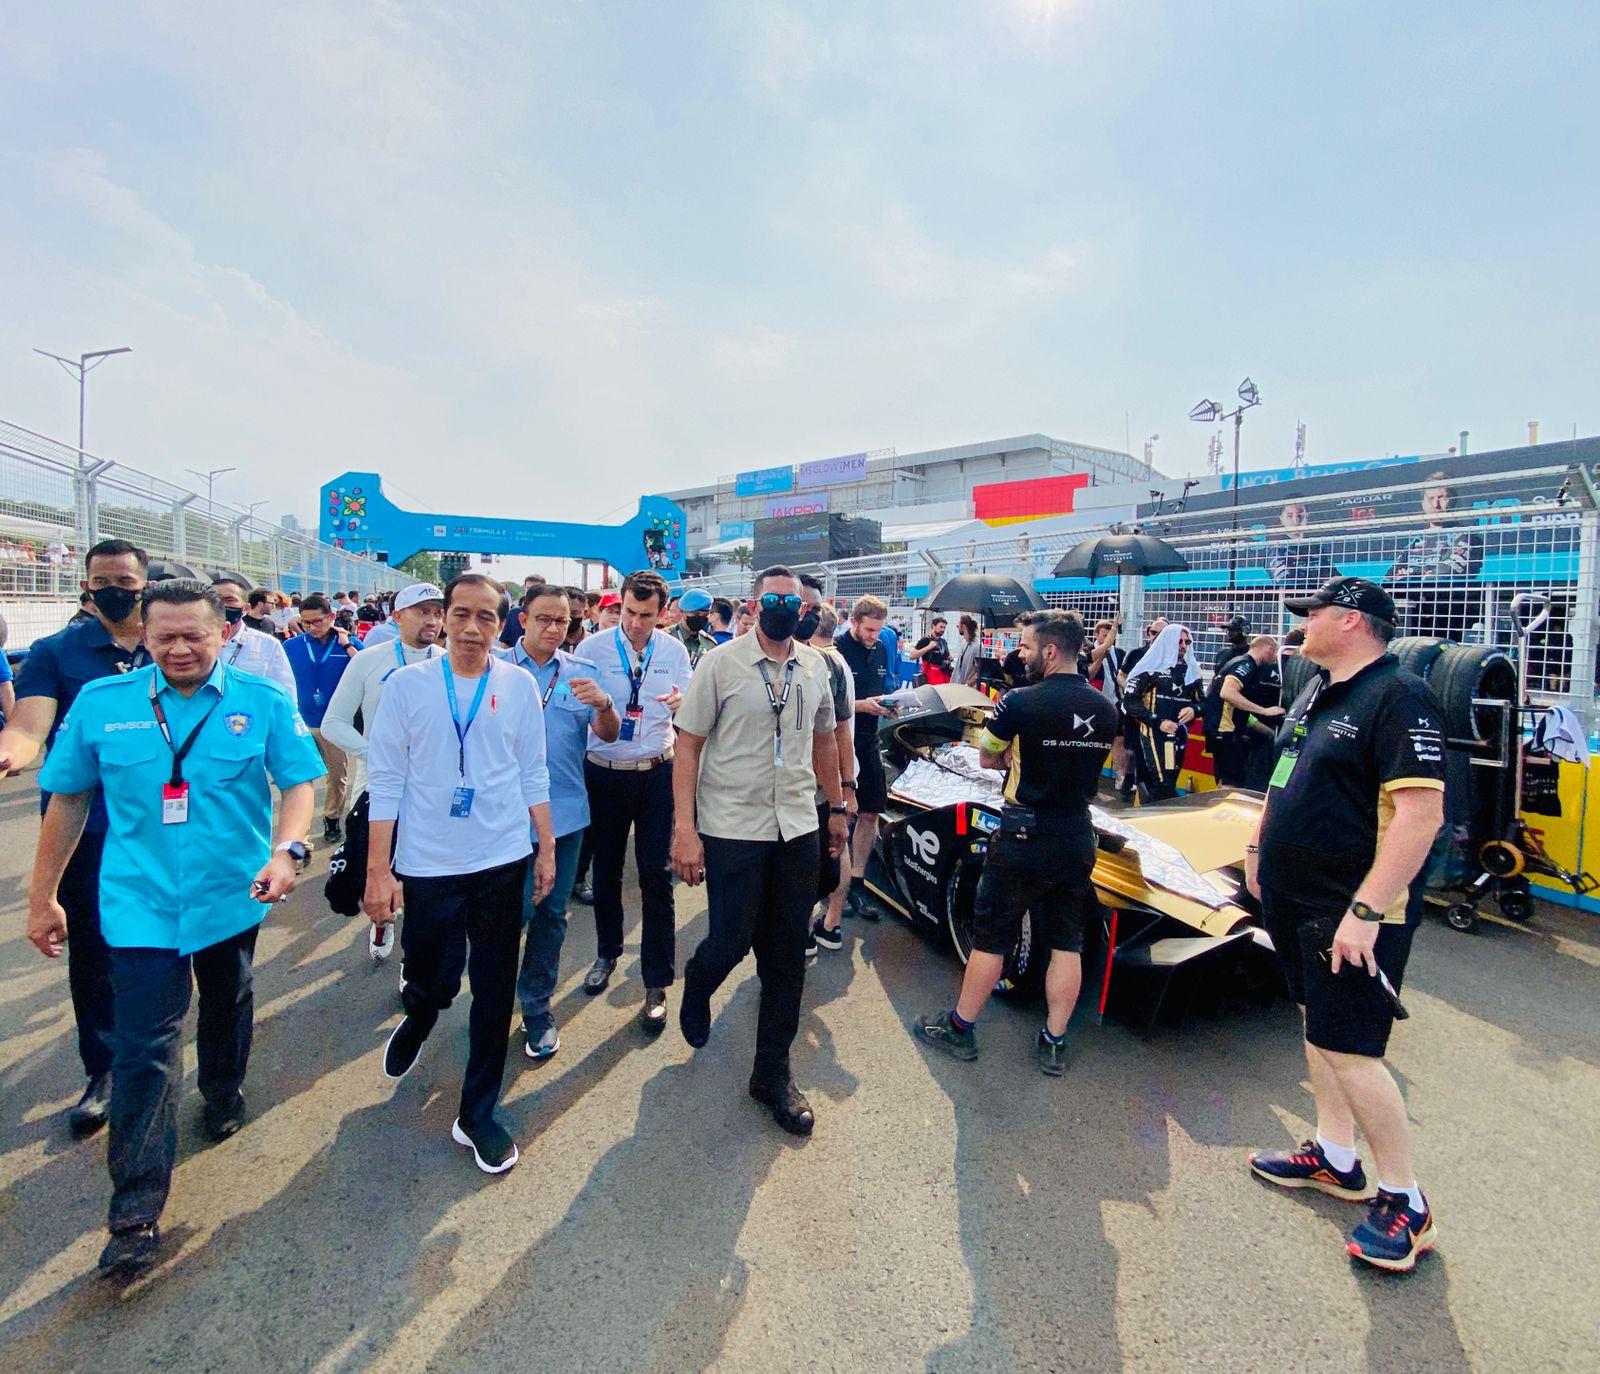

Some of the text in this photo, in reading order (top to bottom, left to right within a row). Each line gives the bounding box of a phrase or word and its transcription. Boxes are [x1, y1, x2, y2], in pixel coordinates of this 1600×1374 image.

[813, 462, 839, 474] GLOW
[844, 459, 865, 471] MEN
[1337, 493, 1393, 507] JAGUAR
[1042, 739, 1057, 747] DS
